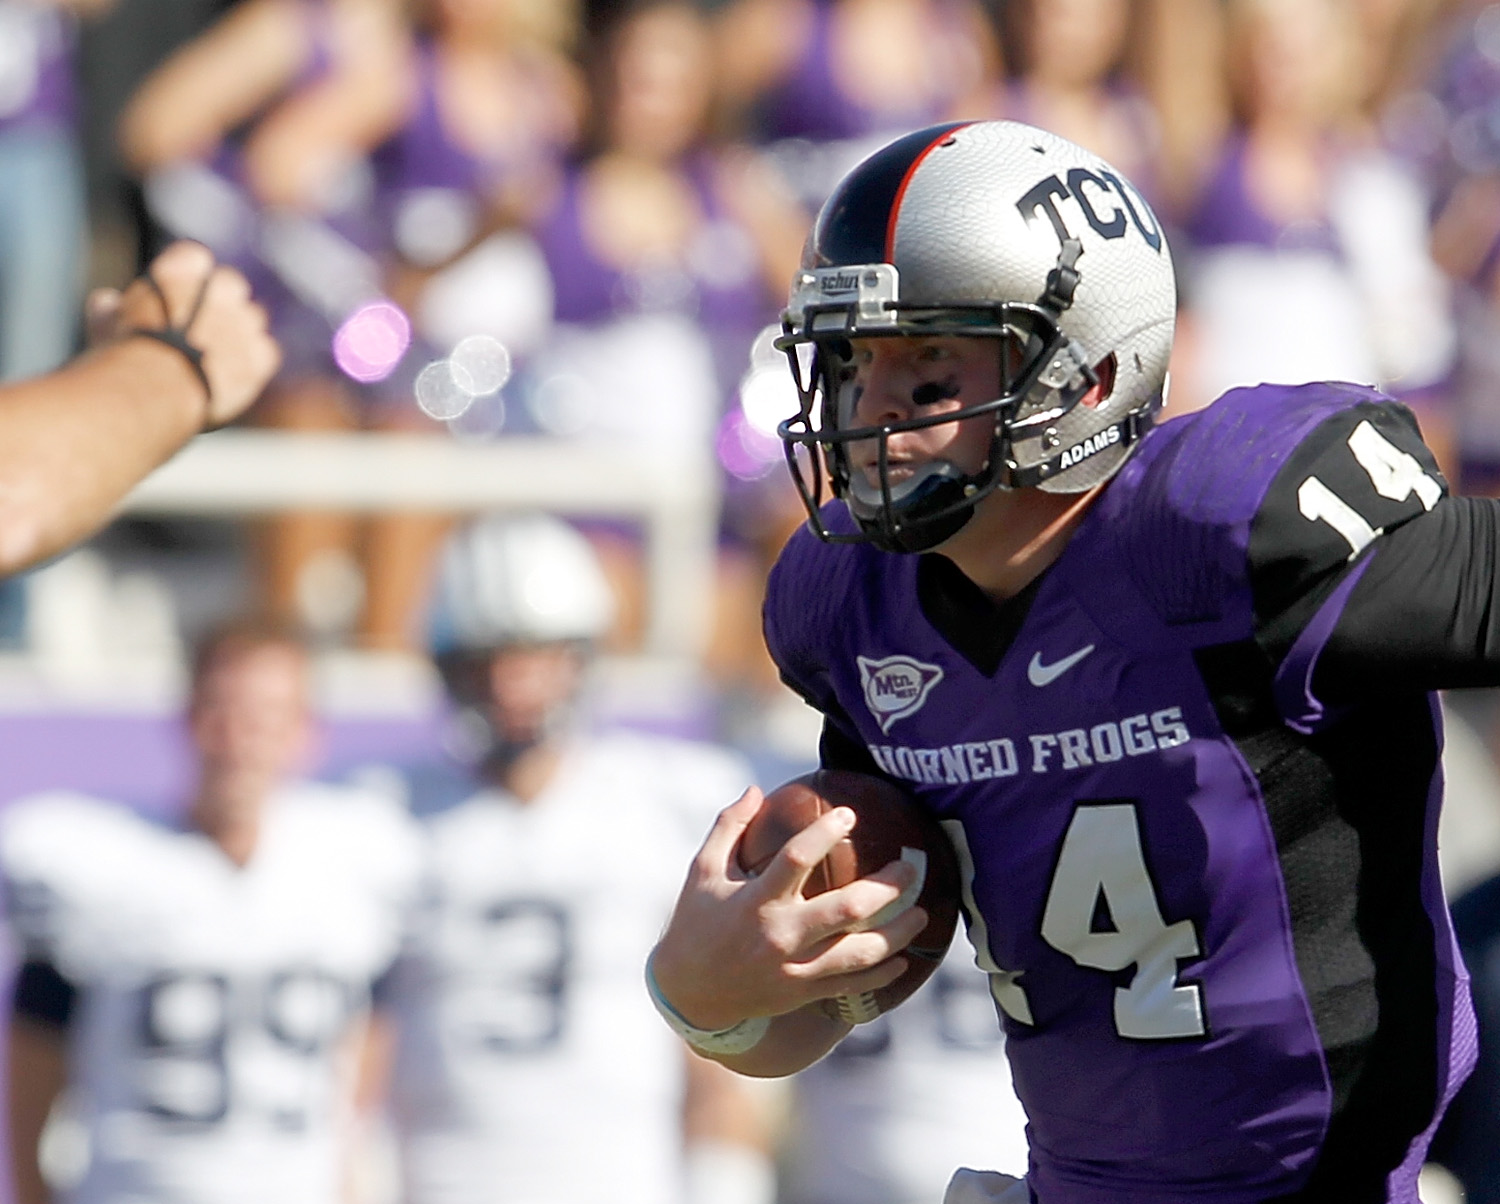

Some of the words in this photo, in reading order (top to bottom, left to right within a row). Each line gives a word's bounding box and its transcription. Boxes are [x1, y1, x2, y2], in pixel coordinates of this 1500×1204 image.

[1060, 425, 1120, 469] ADAMS
[1297, 419, 1443, 562] 14
[869, 738, 1019, 785] HORNED
[1028, 706, 1191, 773] FROGS
